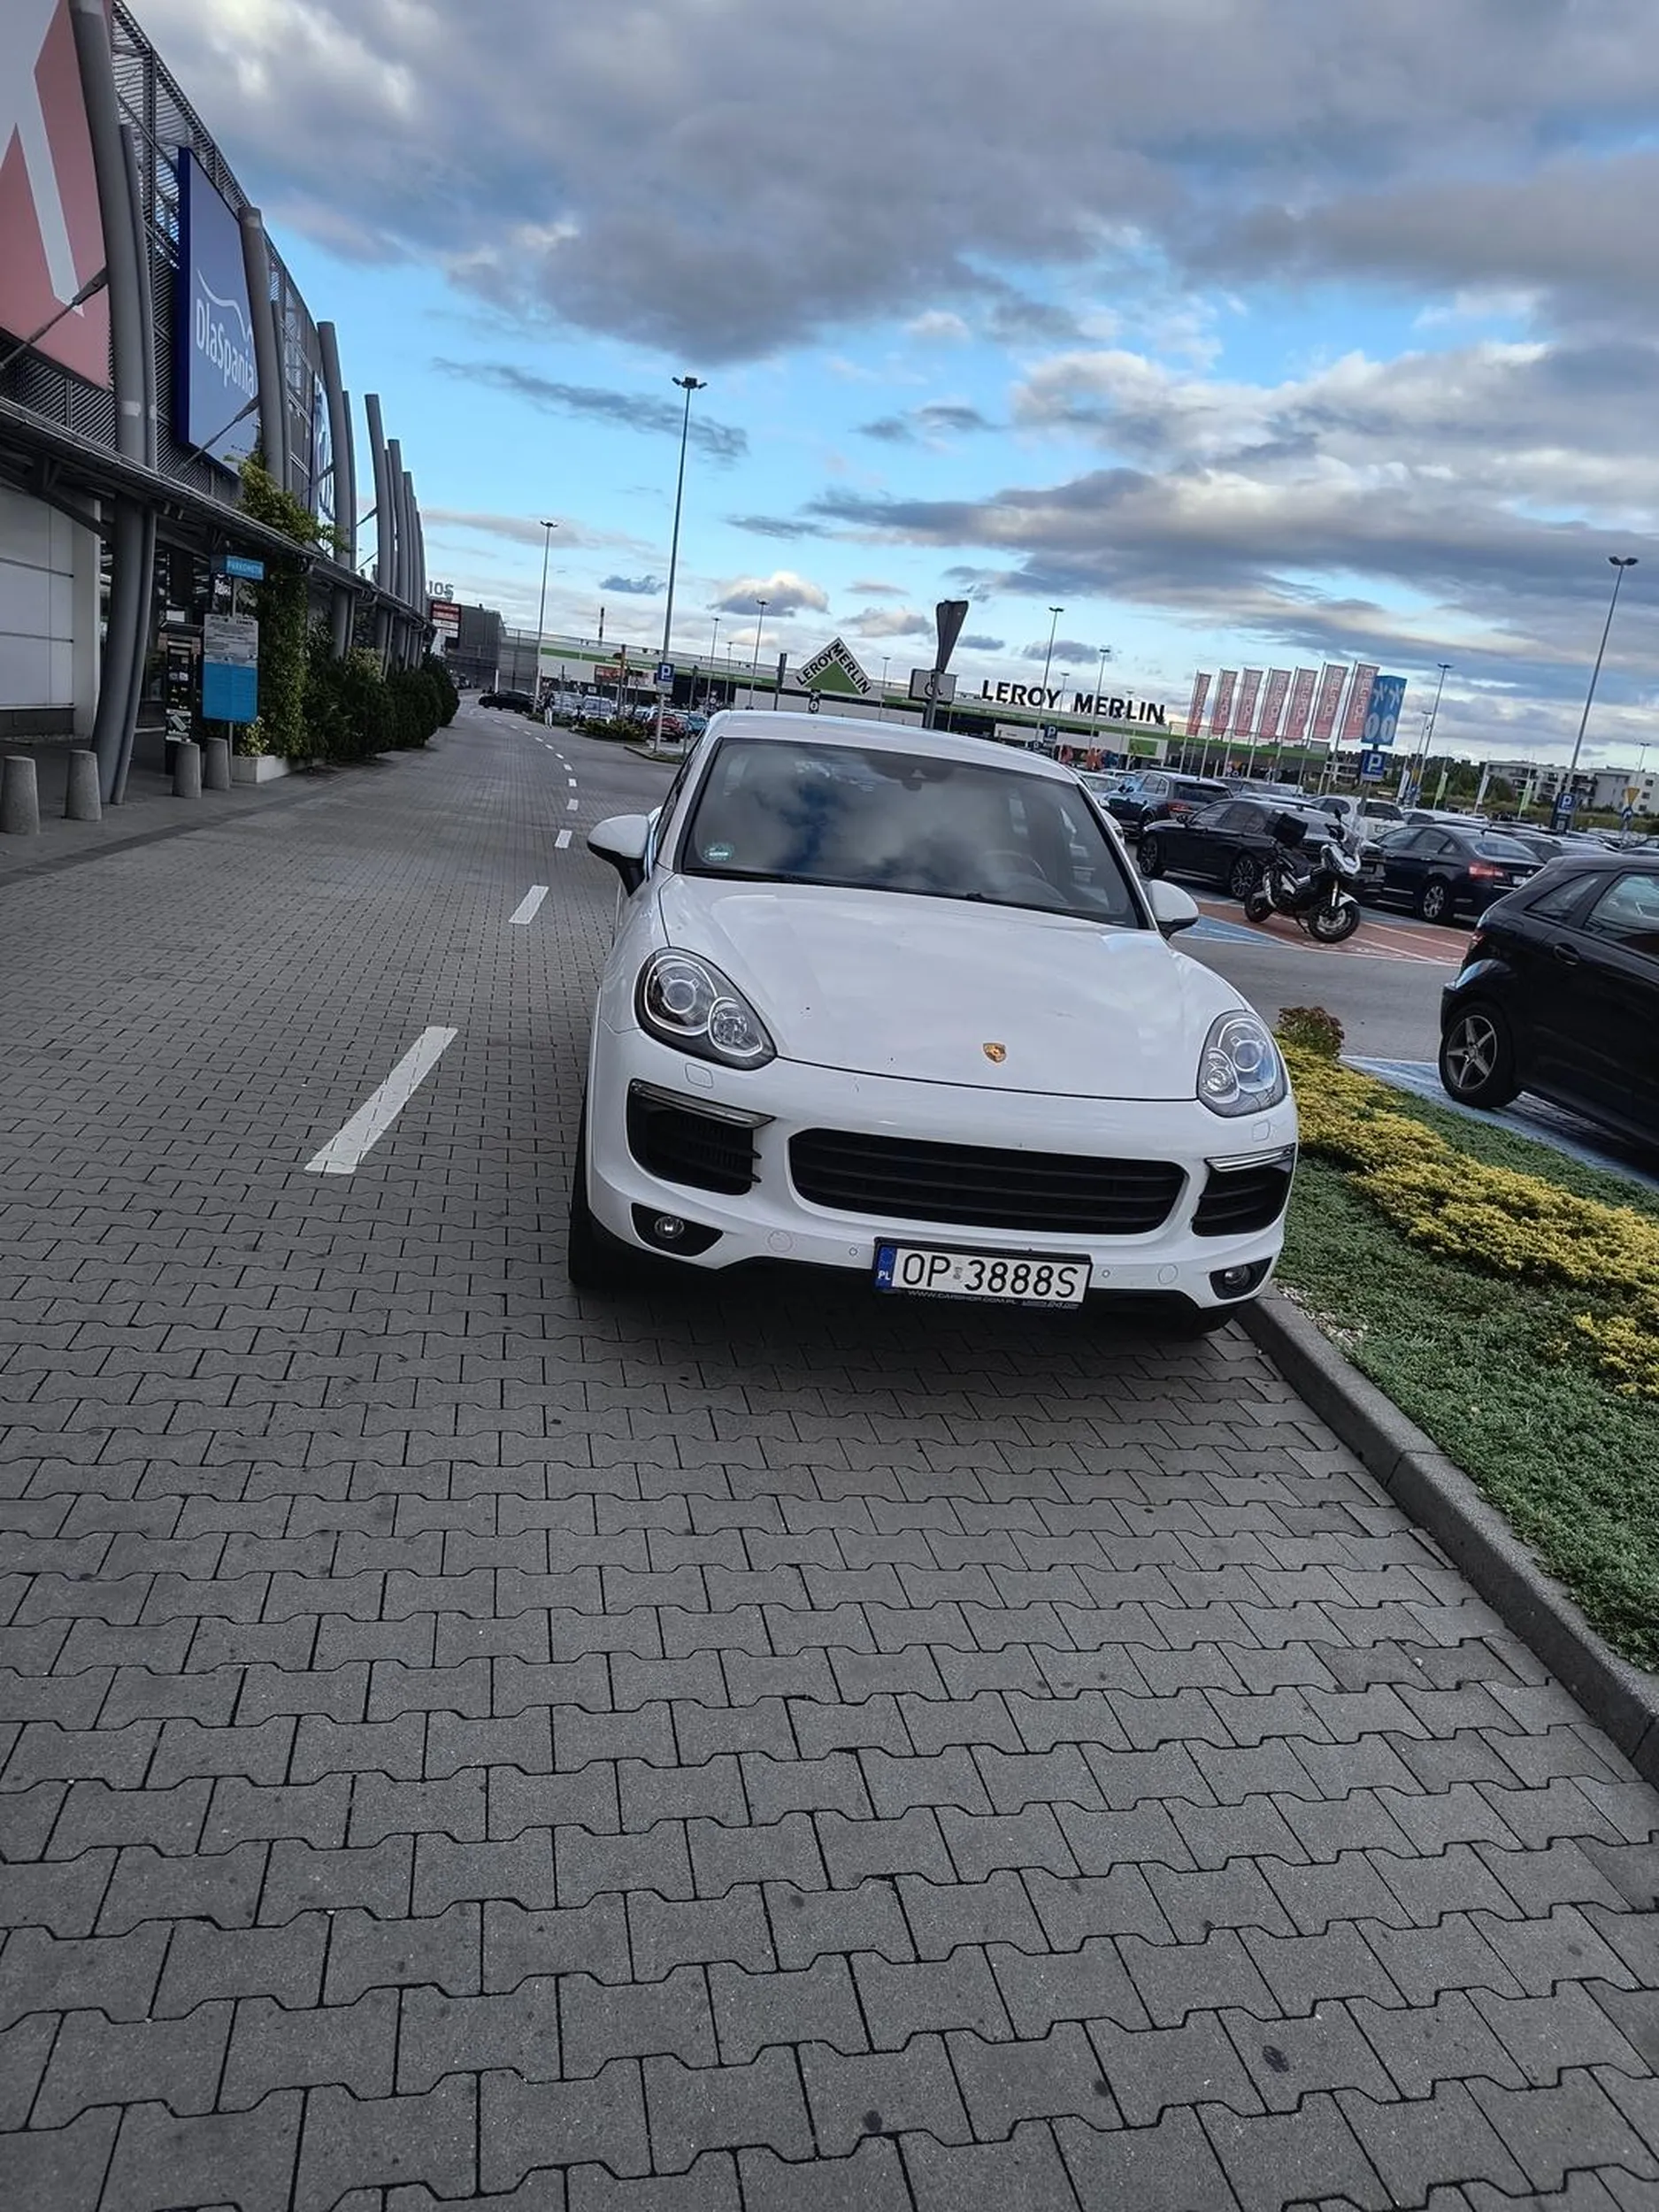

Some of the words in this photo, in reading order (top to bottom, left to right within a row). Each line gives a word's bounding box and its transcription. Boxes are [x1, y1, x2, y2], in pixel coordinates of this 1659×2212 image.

[196, 298, 257, 398] DlaSpania
[796, 649, 833, 686] LEROY
[831, 642, 872, 694] MERLIN
[981, 680, 1061, 709] LEROY
[1073, 693, 1165, 724] MERLIN
[878, 1271, 891, 1280] PL
[902, 1253, 951, 1286] OP
[964, 1259, 1079, 1298] 3888S
